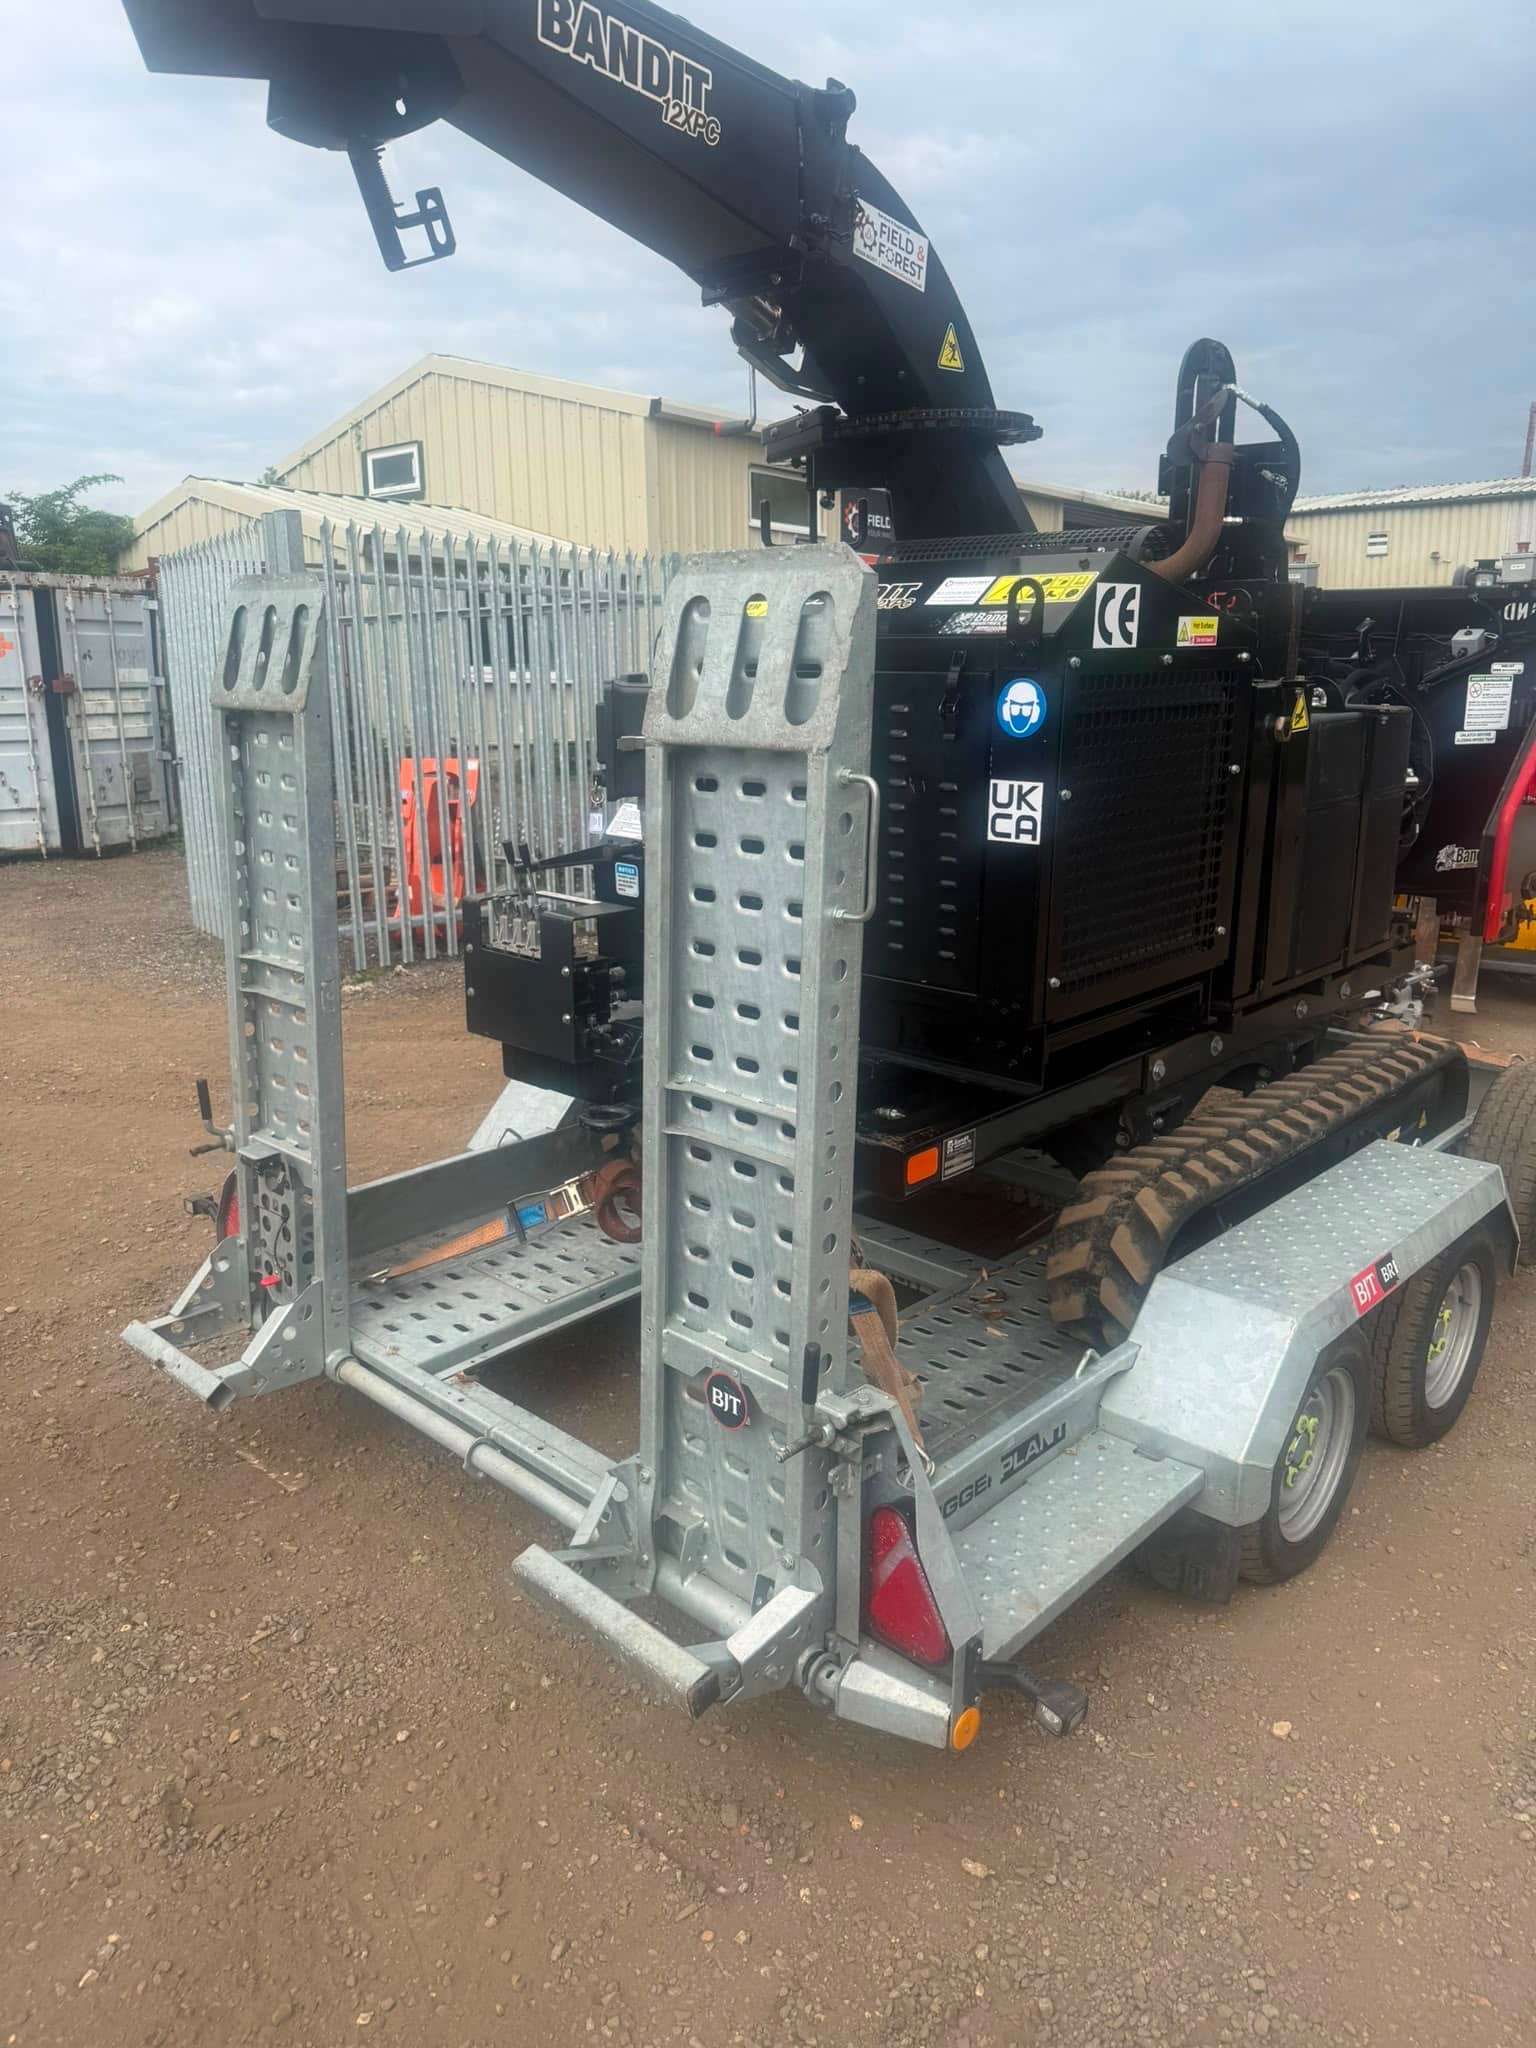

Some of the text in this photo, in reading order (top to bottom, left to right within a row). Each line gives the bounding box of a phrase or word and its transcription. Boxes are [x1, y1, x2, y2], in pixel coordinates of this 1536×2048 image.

[538, 0, 713, 114] BANDIT
[662, 97, 721, 146] 12XPC
[880, 222, 914, 255] FIELD
[917, 245, 925, 263] &
[1098, 585, 1136, 646] CE
[992, 783, 1040, 812] UK
[991, 812, 1038, 842] CA
[1354, 1272, 1377, 1306] BJT
[712, 1386, 741, 1416] BJT
